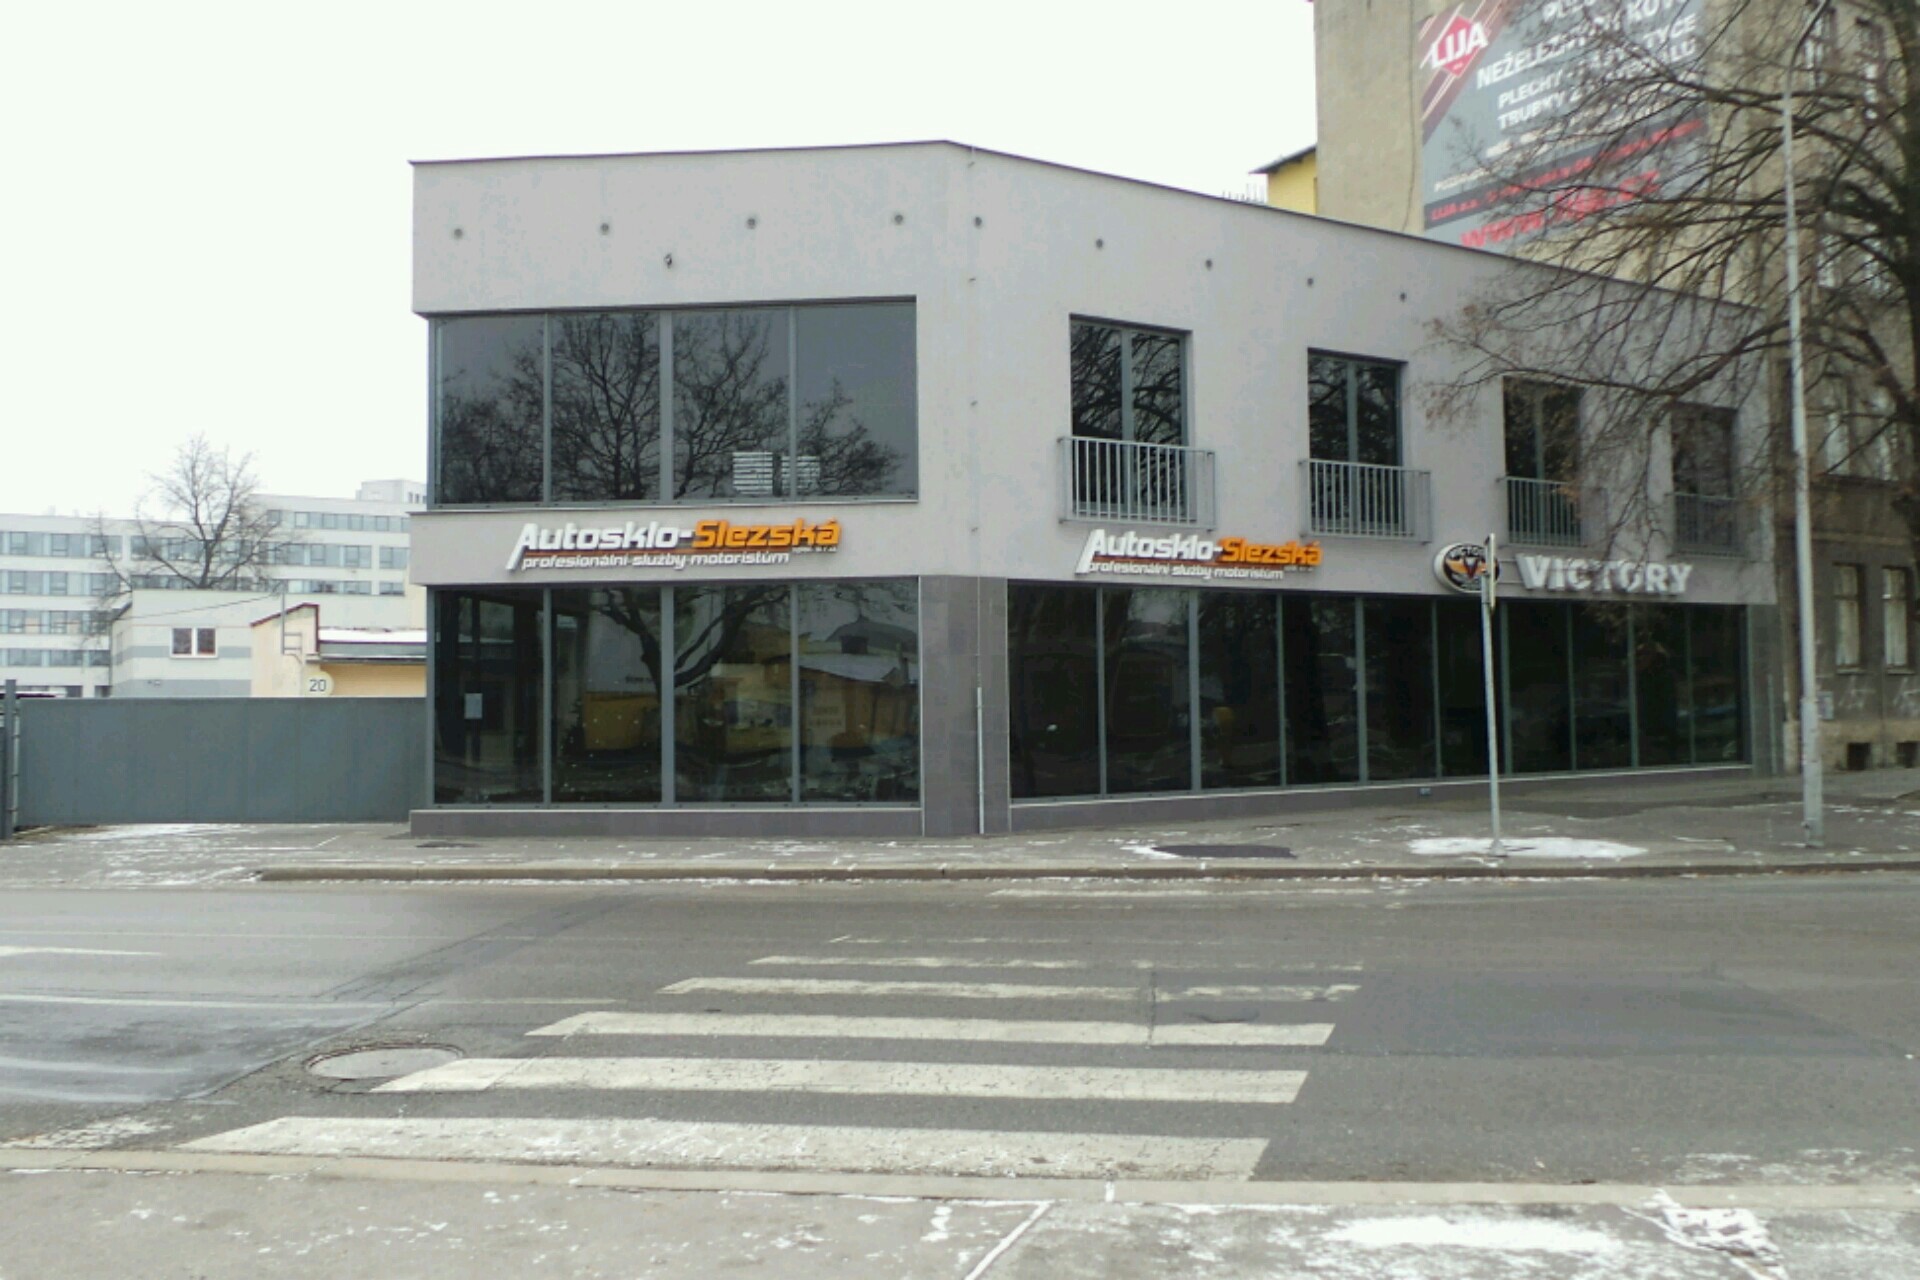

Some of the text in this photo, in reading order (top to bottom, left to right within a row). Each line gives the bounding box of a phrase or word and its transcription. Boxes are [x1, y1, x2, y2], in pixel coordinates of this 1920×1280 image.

[521, 553, 628, 571] profesionální
[631, 552, 687, 571] služby
[1515, 553, 1693, 594] VICTORY
[309, 679, 326, 692] 20
